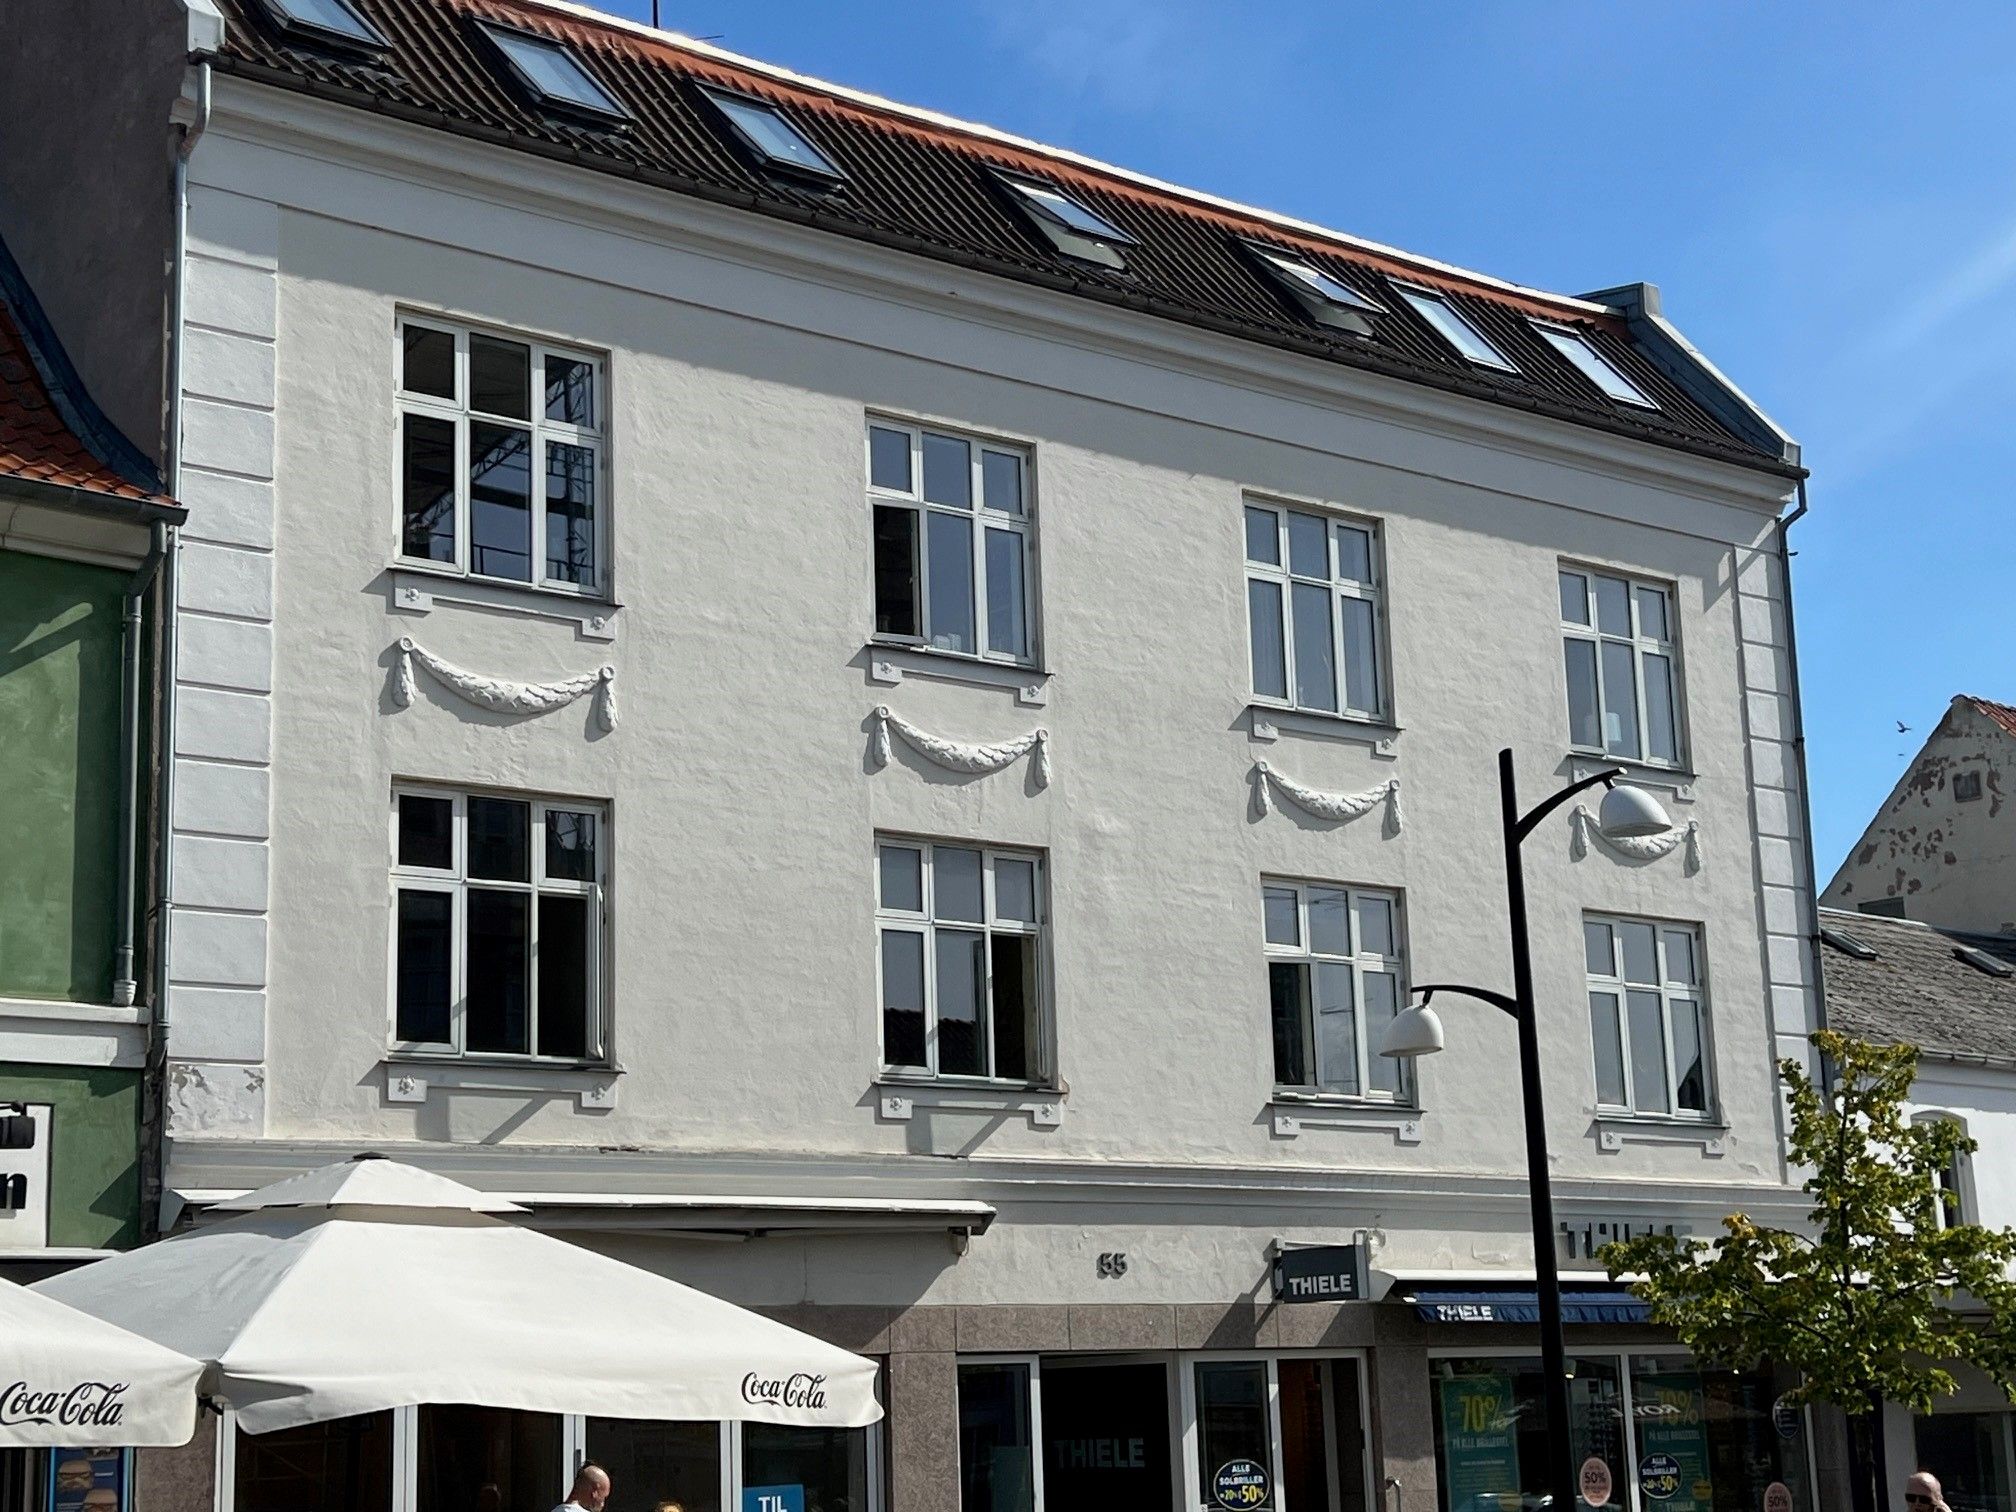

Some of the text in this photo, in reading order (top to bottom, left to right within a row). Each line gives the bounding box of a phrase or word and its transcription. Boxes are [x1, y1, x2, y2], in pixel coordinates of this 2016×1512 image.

[1097, 1252, 1128, 1279] 55
[1288, 1273, 1352, 1295] THIELE
[1436, 1304, 1494, 1321] THIELE
[1053, 1438, 1146, 1468] THIELE
